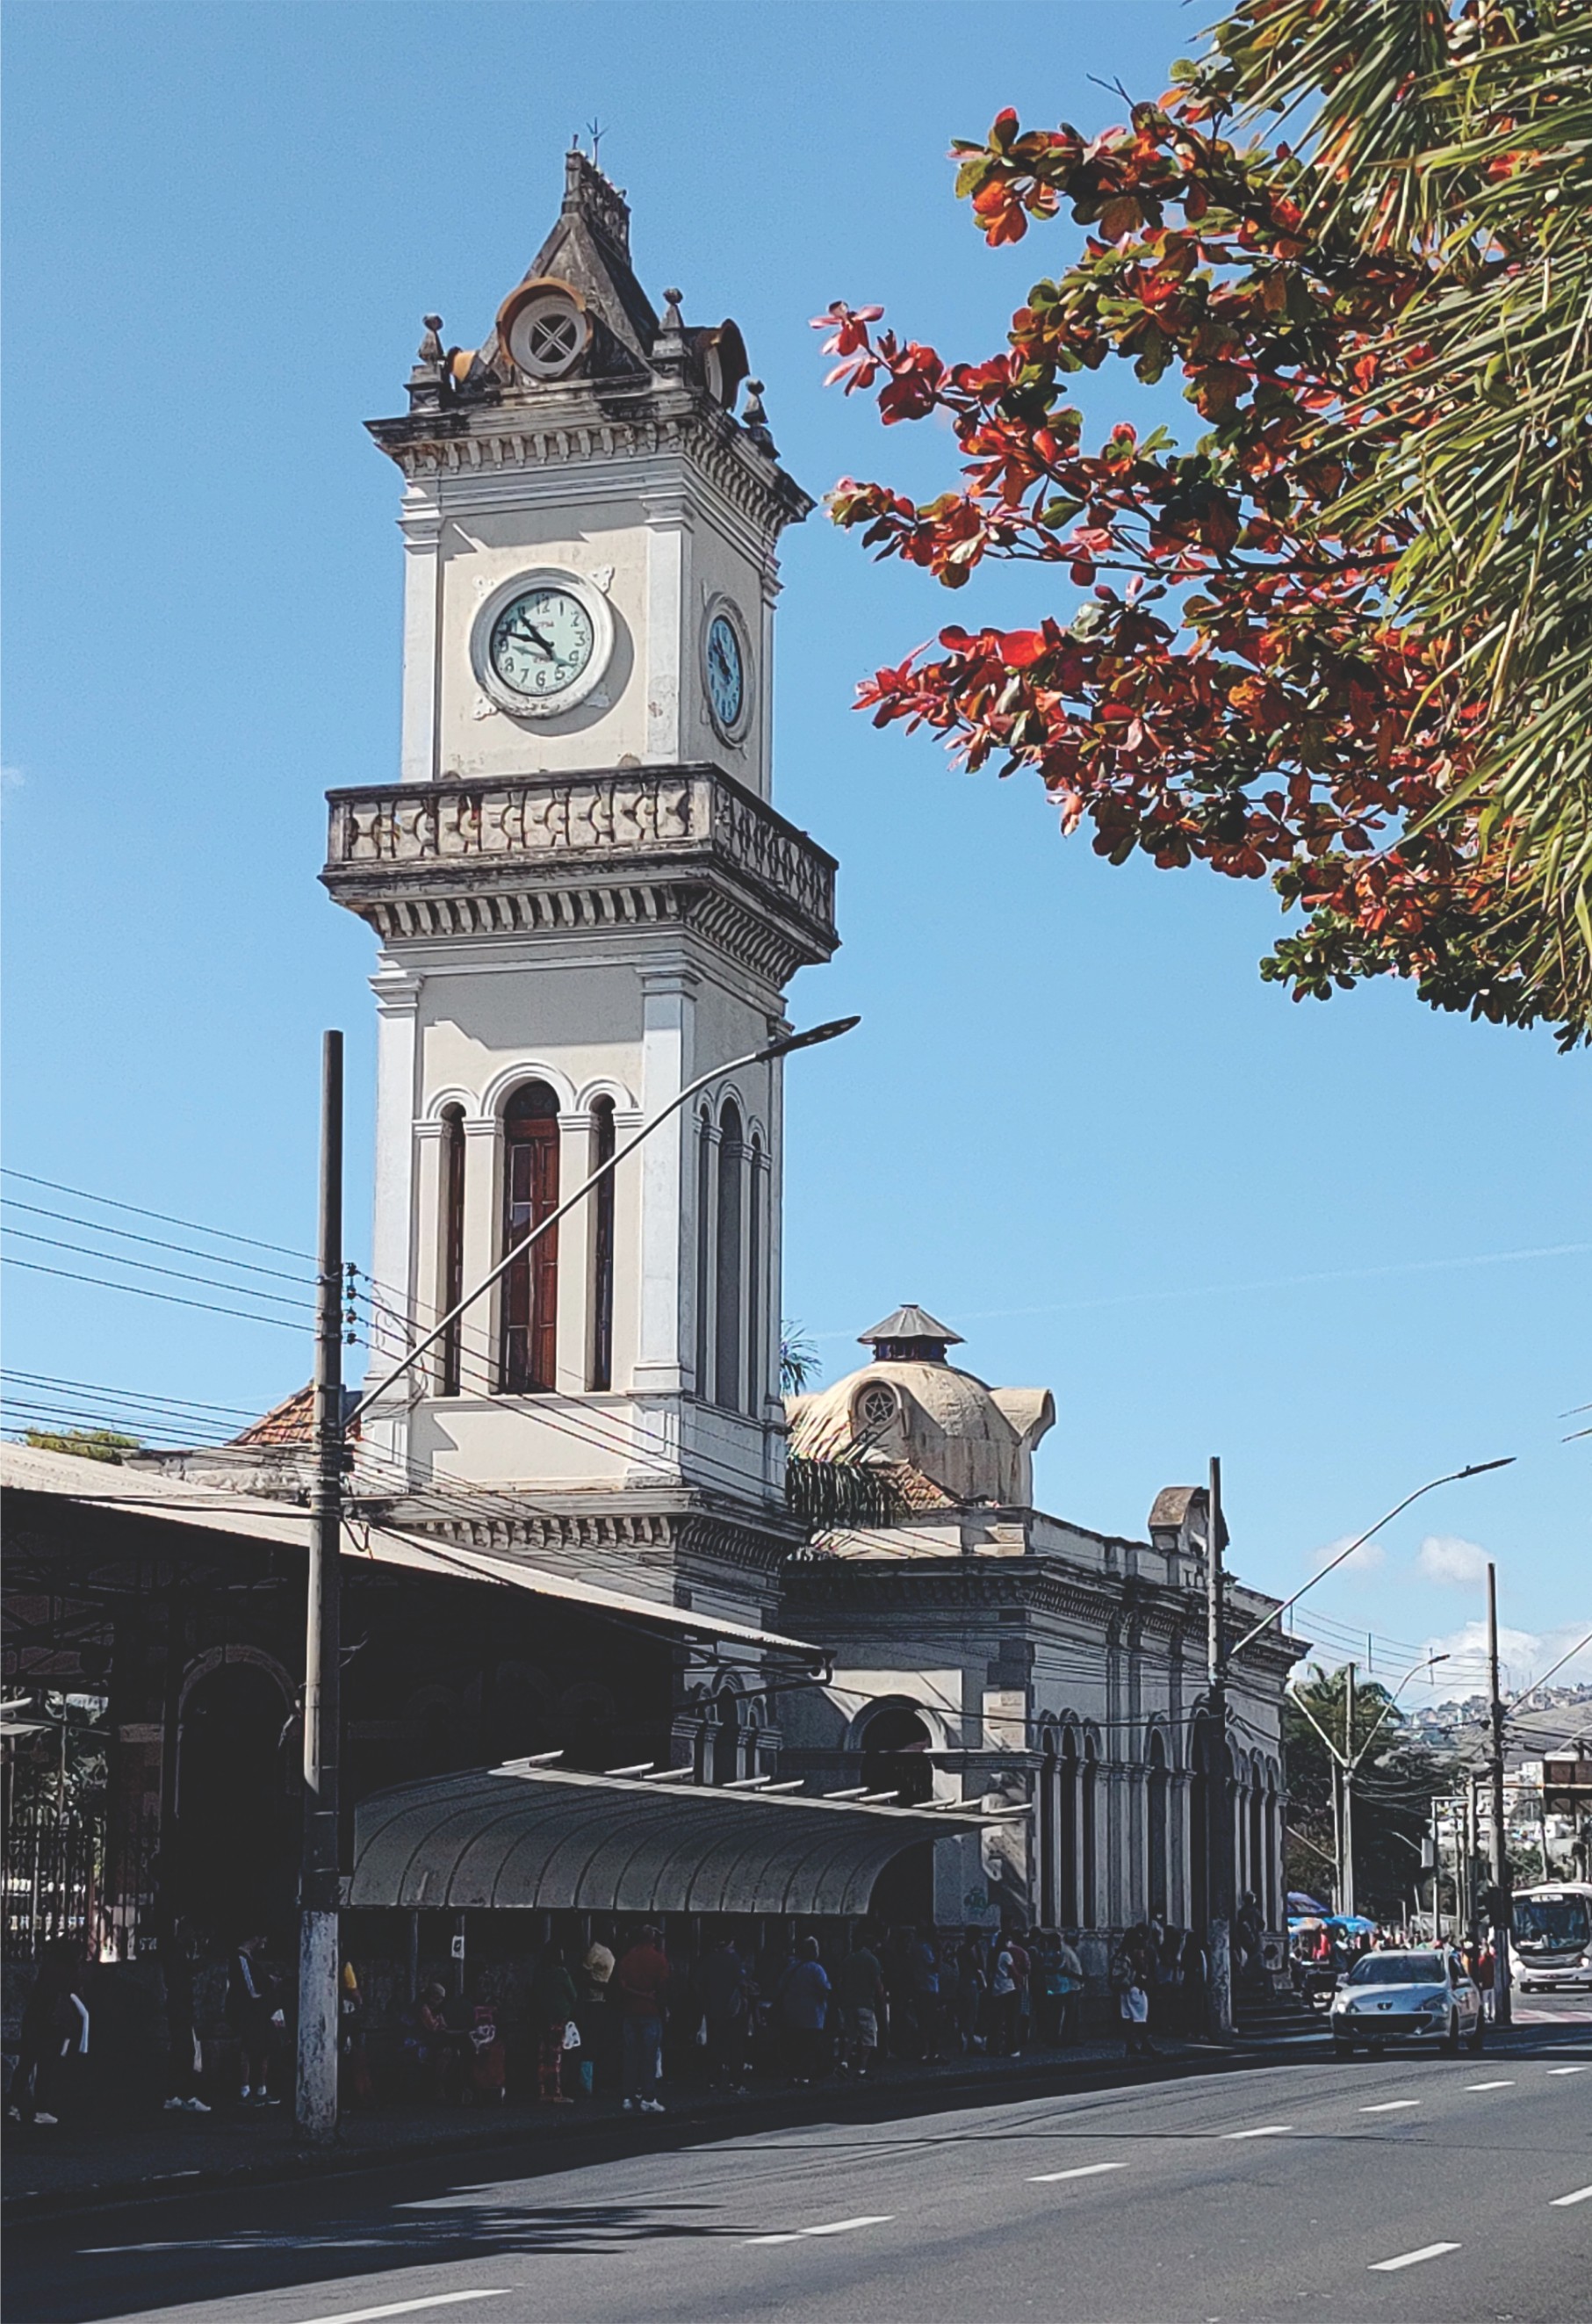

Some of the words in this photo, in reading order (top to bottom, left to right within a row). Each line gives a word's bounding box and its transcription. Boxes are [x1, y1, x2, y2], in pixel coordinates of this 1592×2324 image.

[537, 596, 551, 615] 12
[570, 610, 580, 628] 2
[574, 631, 586, 647] 3
[504, 656, 515, 674] 8
[521, 668, 529, 684] 7
[536, 670, 546, 688] 6
